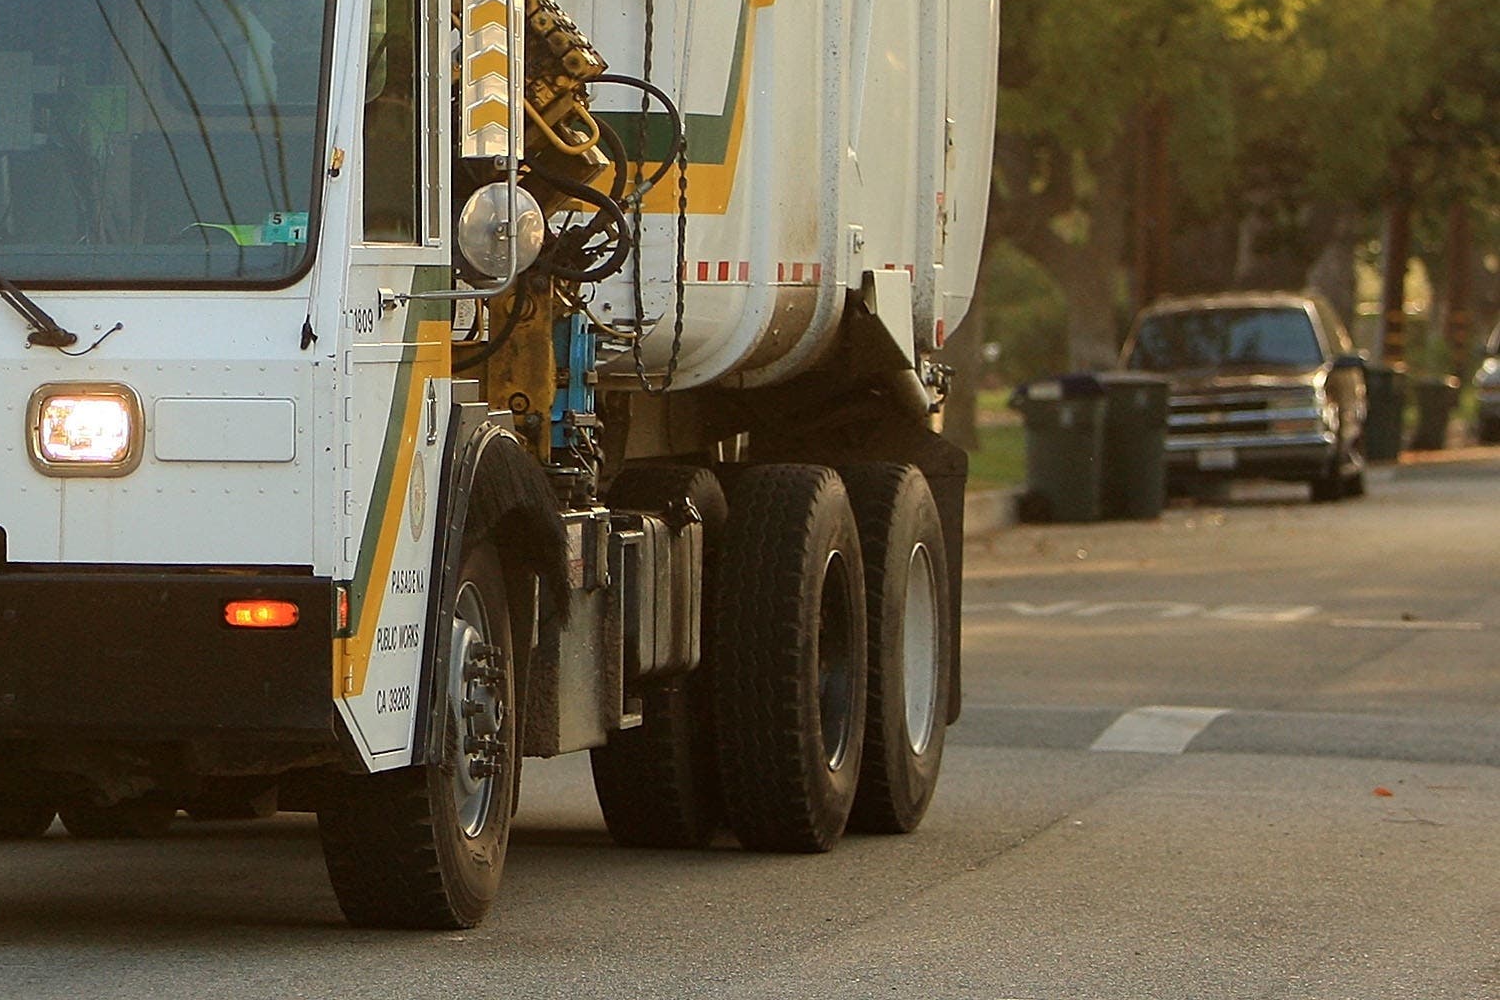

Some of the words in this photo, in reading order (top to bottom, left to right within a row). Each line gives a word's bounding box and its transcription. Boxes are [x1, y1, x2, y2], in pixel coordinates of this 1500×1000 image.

[349, 308, 374, 334] 1809
[392, 571, 424, 593] PASADENA
[377, 628, 397, 651] PUBLIC
[377, 690, 387, 714] CA
